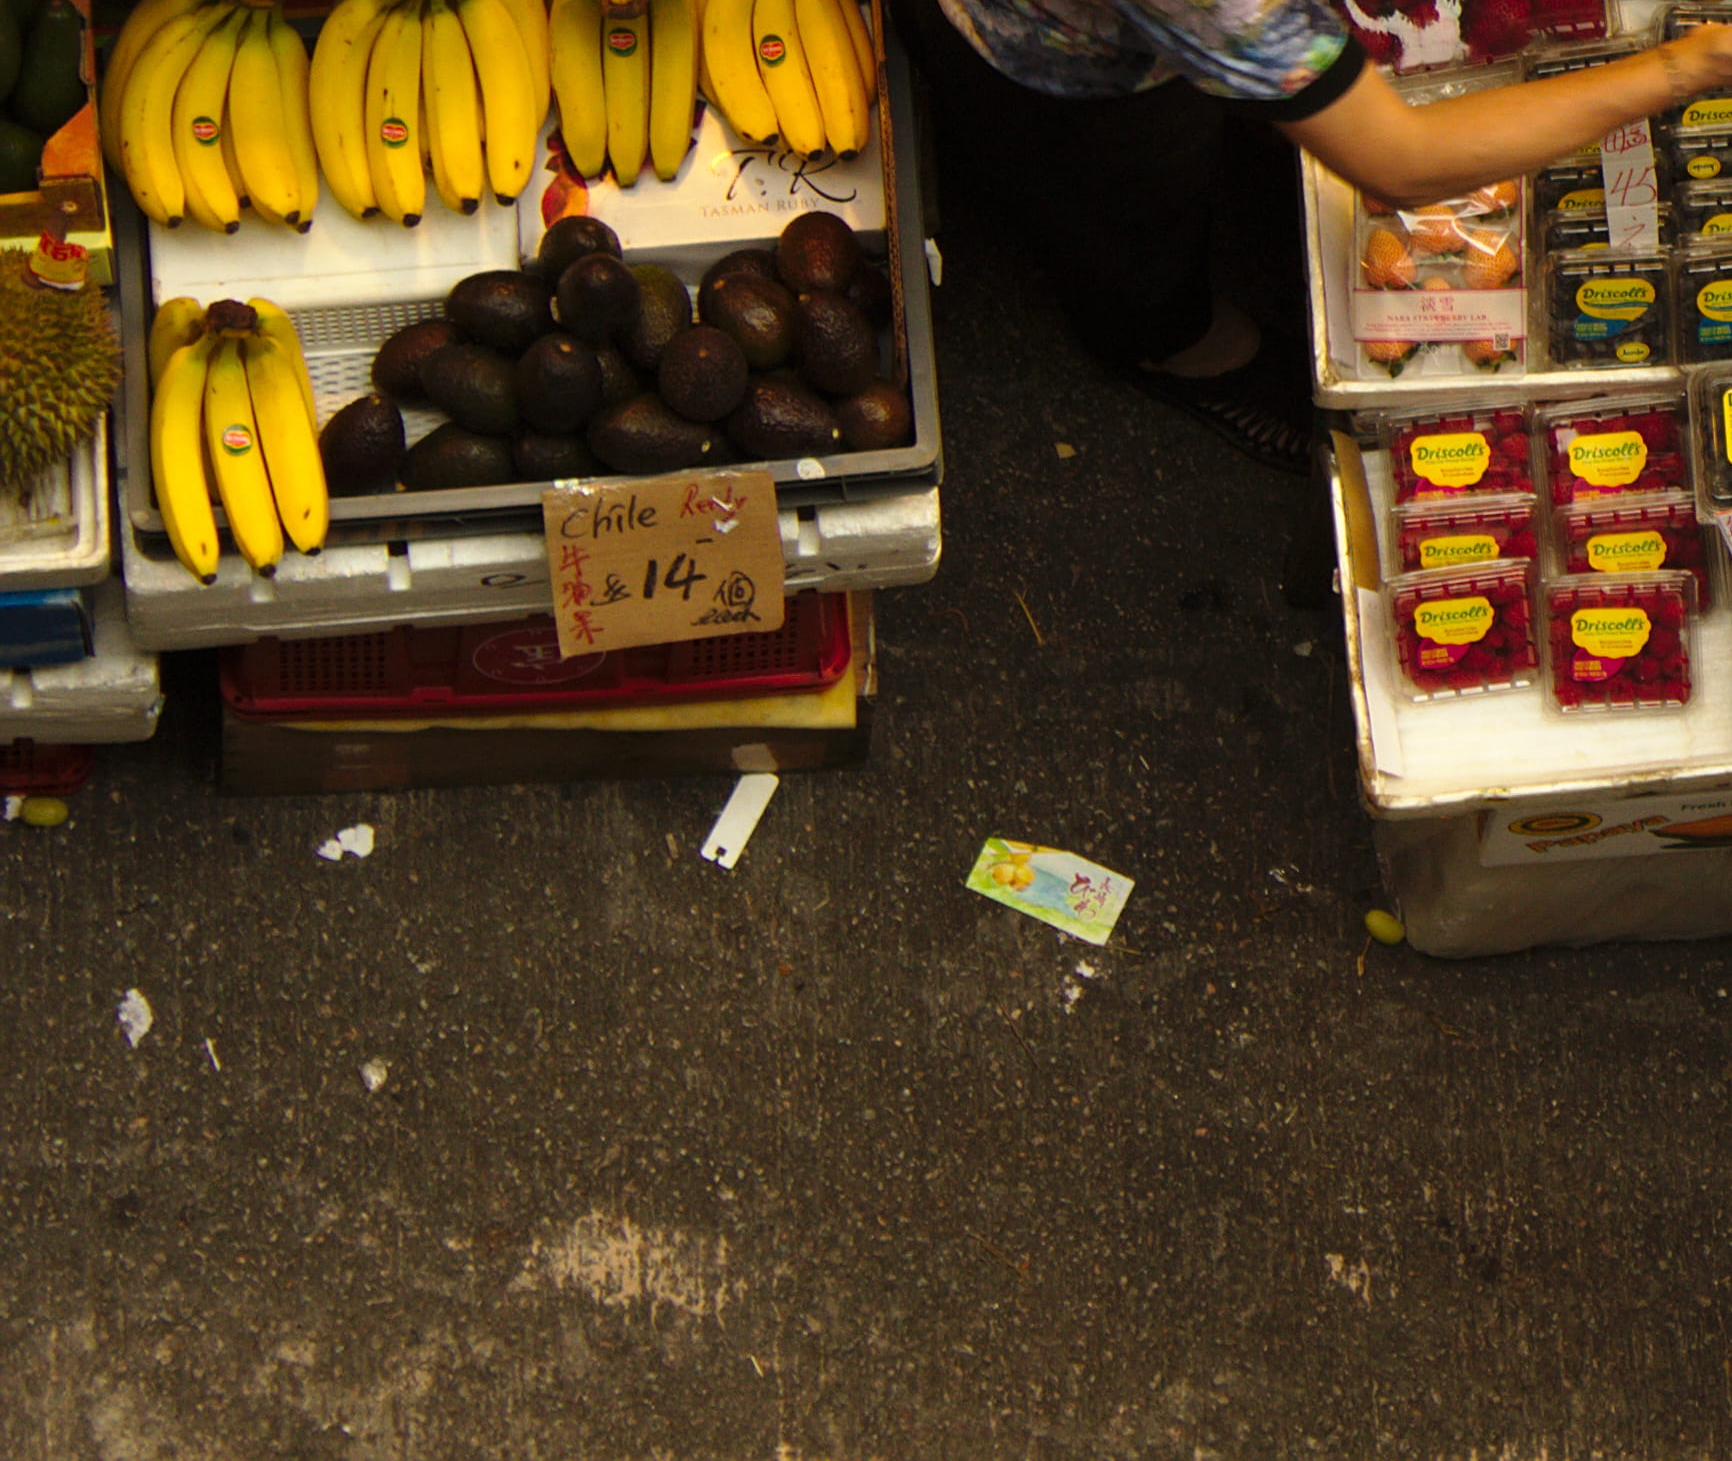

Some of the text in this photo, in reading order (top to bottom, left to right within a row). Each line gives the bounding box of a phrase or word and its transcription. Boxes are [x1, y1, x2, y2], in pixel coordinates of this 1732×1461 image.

[1609, 165, 1658, 208] 45
[700, 197, 821, 219] TASMAN RUBY
[1582, 286, 1649, 301] Driscoll's
[1416, 442, 1485, 461] Driscoll's
[1572, 442, 1642, 461] Driscoll's
[560, 495, 657, 539] Chile
[1423, 540, 1494, 559] Driscoll's
[1592, 540, 1662, 558] Driscoll's
[643, 552, 706, 602] 14
[1419, 605, 1489, 624] Driscoll's
[1575, 616, 1646, 634] Driscoll's
